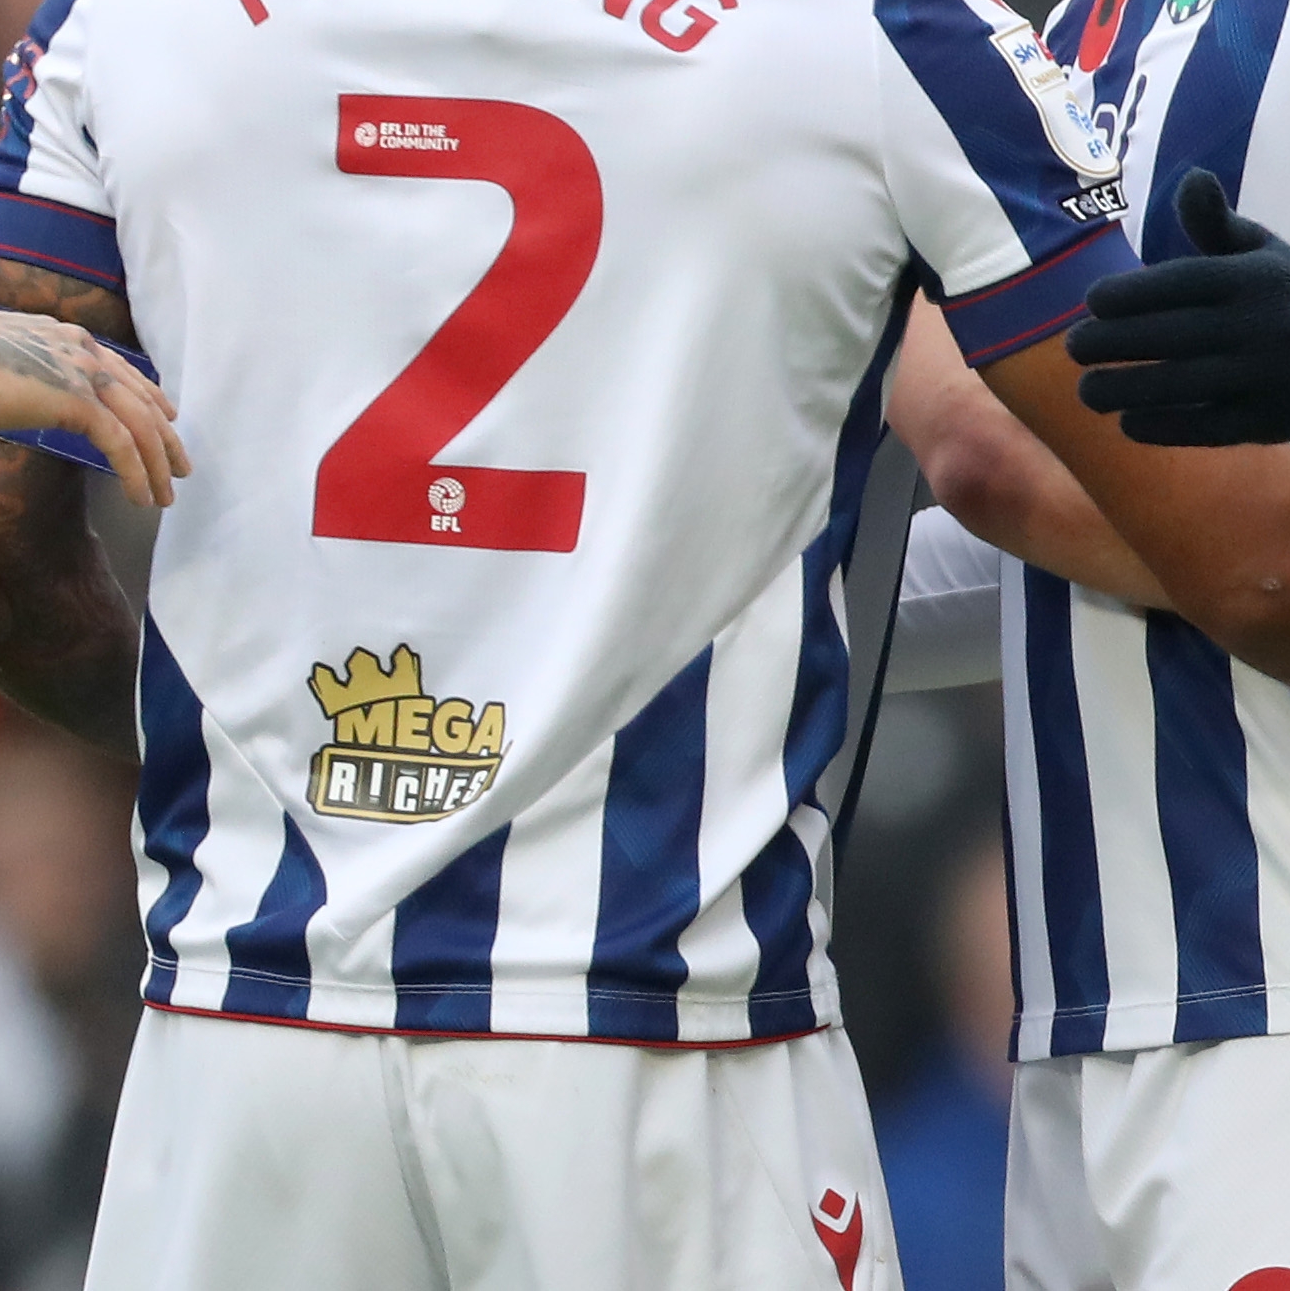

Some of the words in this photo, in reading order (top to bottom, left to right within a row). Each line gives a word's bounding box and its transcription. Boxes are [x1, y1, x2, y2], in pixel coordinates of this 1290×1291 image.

[1013, 41, 1042, 65] sky
[379, 122, 403, 136] EFL
[404, 123, 421, 136] IN
[421, 124, 447, 138] THE
[379, 135, 460, 151] COMMUNITY
[311, 93, 604, 553] 2
[429, 514, 462, 533] EFL
[335, 697, 505, 756] MEGA
[327, 760, 489, 812] RICHES
